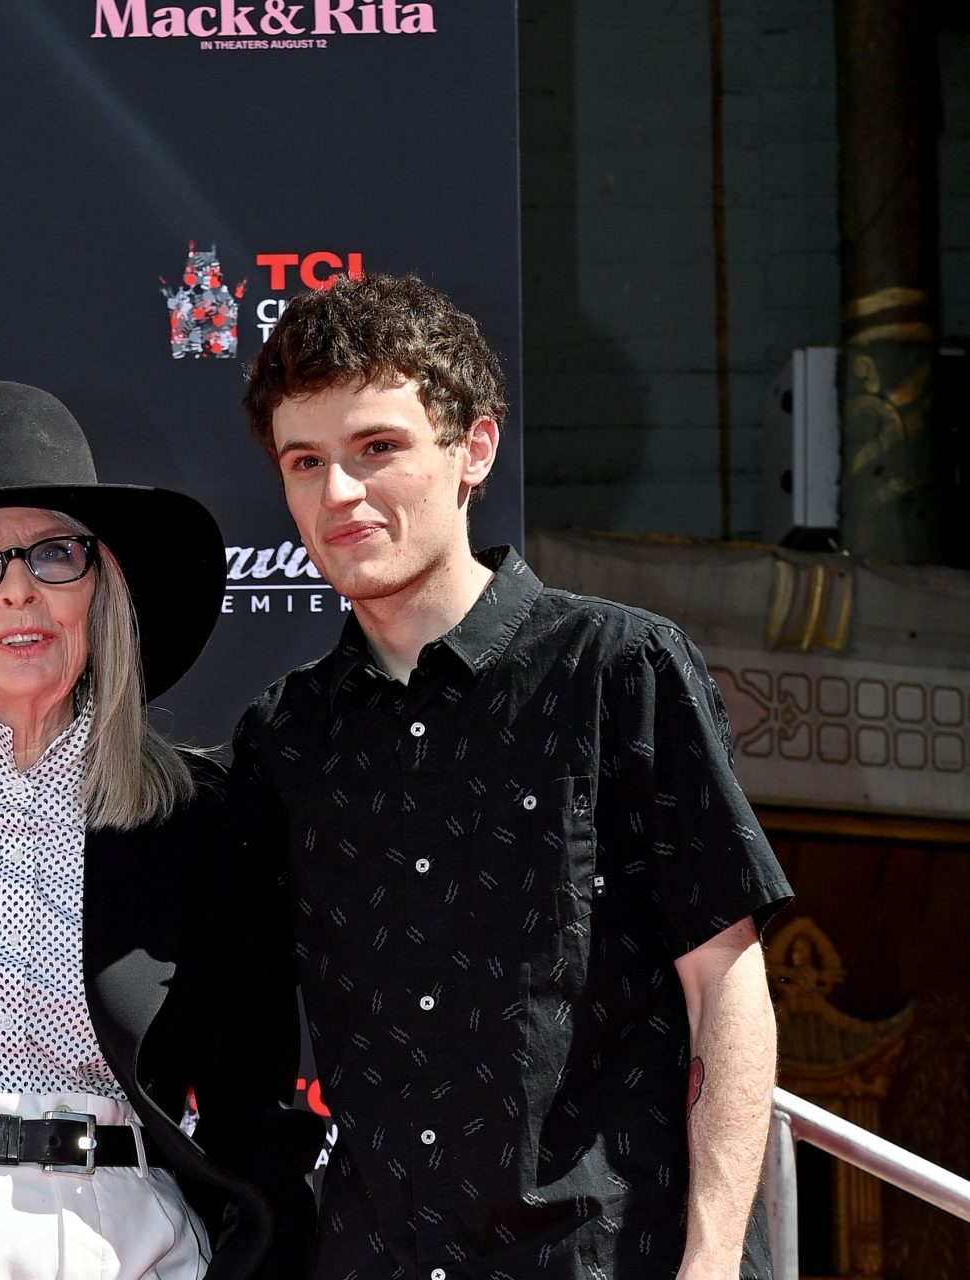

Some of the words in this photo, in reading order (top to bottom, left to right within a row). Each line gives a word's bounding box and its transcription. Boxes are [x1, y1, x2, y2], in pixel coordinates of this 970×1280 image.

[200, 41, 212, 50] IN
[214, 40, 269, 50] THEATERS
[270, 39, 314, 49] AUGUST
[316, 39, 327, 48] 12
